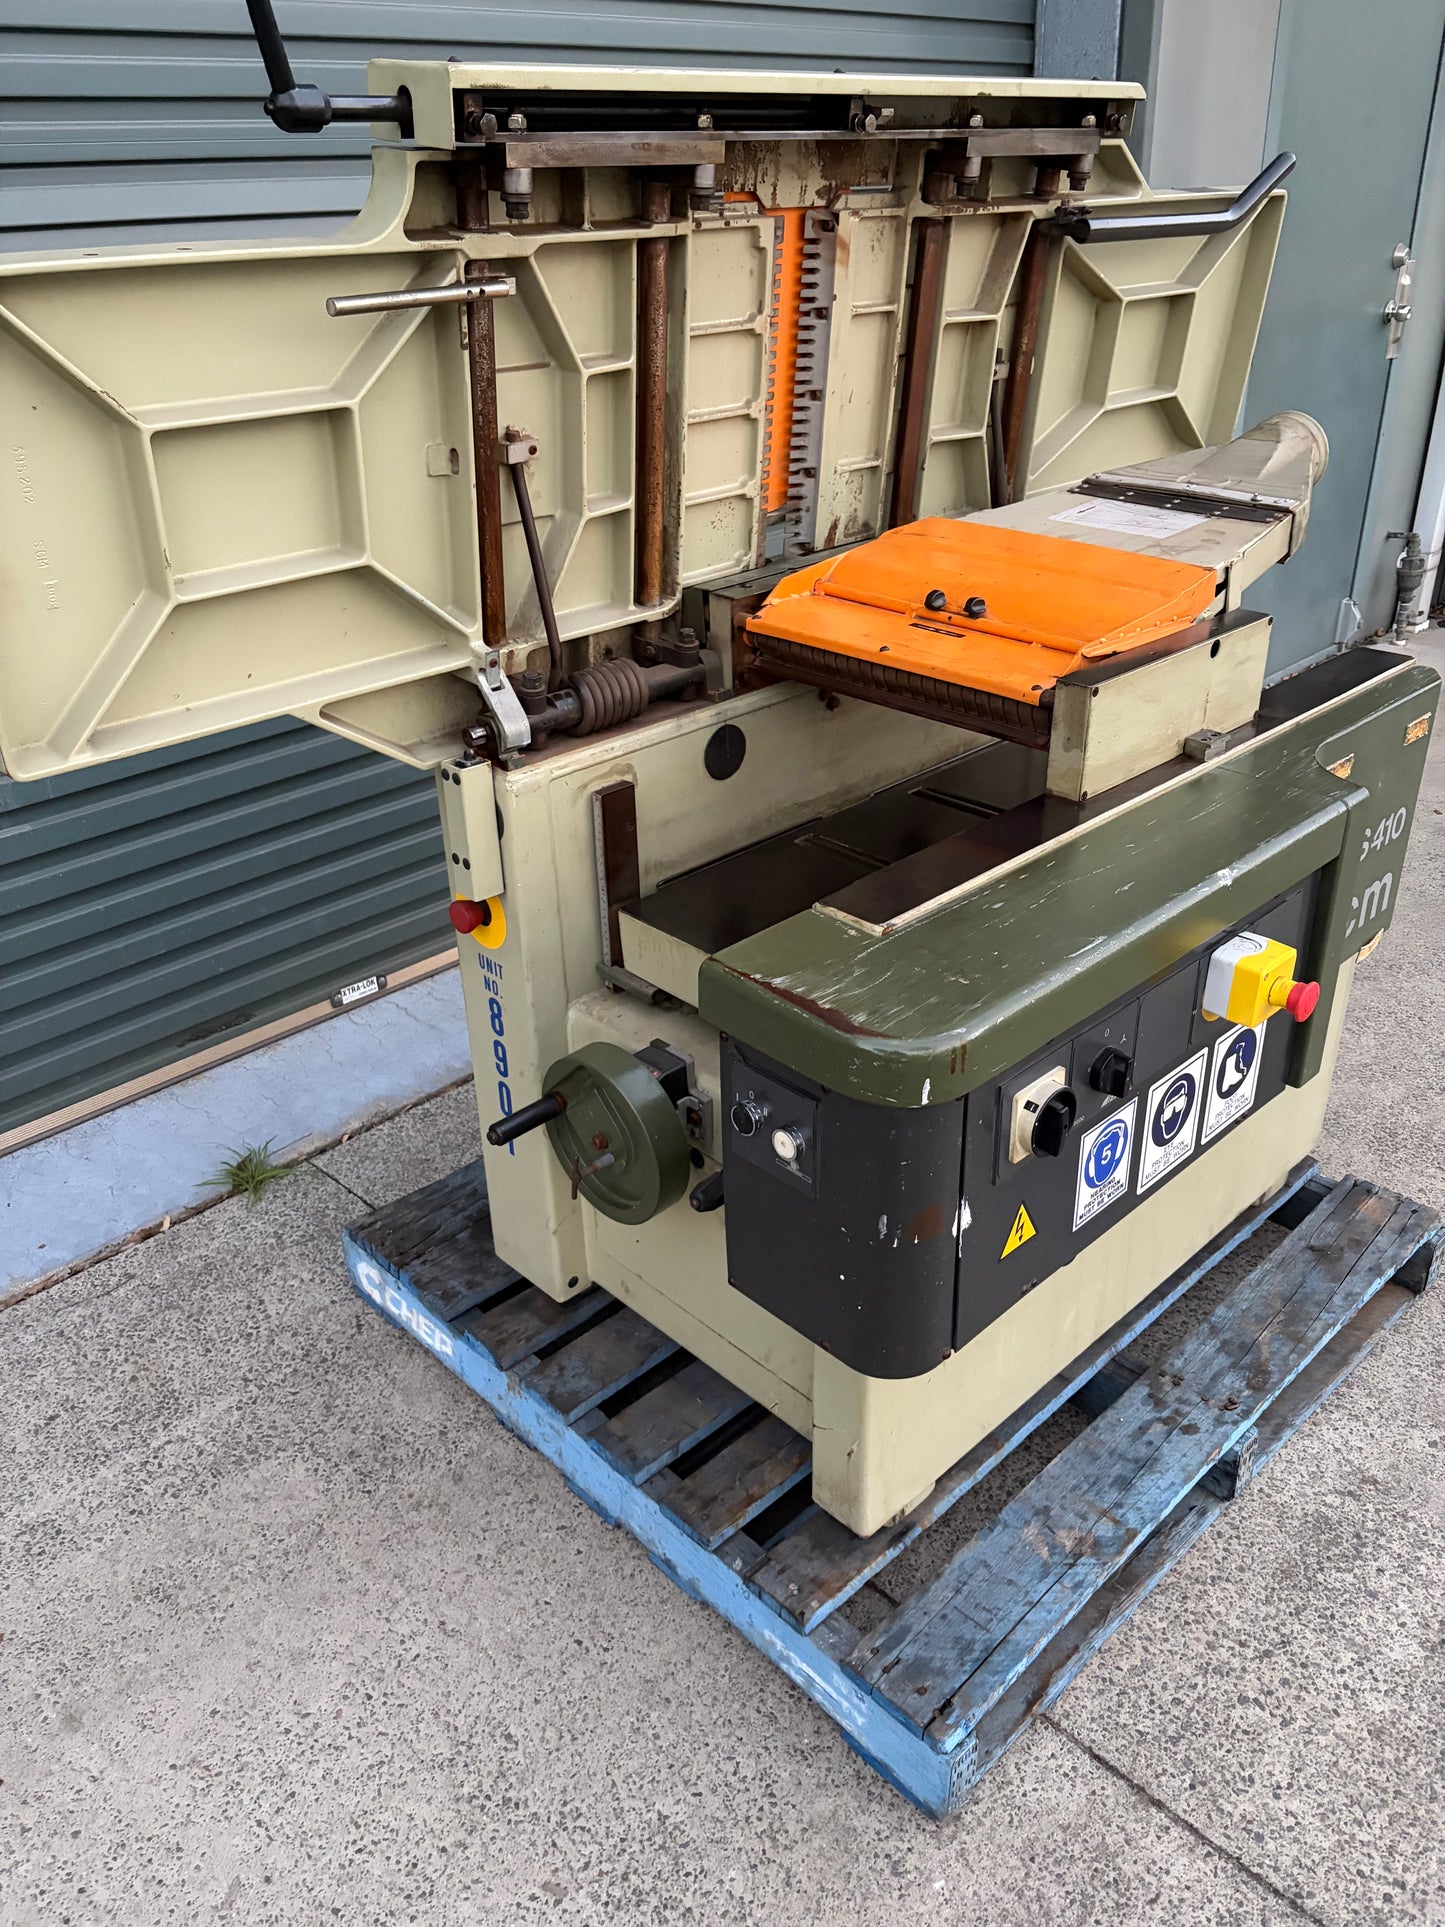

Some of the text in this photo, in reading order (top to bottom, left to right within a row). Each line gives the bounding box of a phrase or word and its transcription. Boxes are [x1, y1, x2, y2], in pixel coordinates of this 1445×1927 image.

[478, 952, 503, 980] UNIT
[342, 979, 376, 997] XTRA-LOK
[484, 975, 503, 999] NO.
[1145, 1142, 1189, 1180] MUST BE WORN
[1152, 1139, 1185, 1169] PROTECTION
[1079, 1183, 1124, 1221] MUST BE WORN
[1084, 1178, 1121, 1211] PROTECTION
[1091, 1177, 1115, 1199] HEARING
